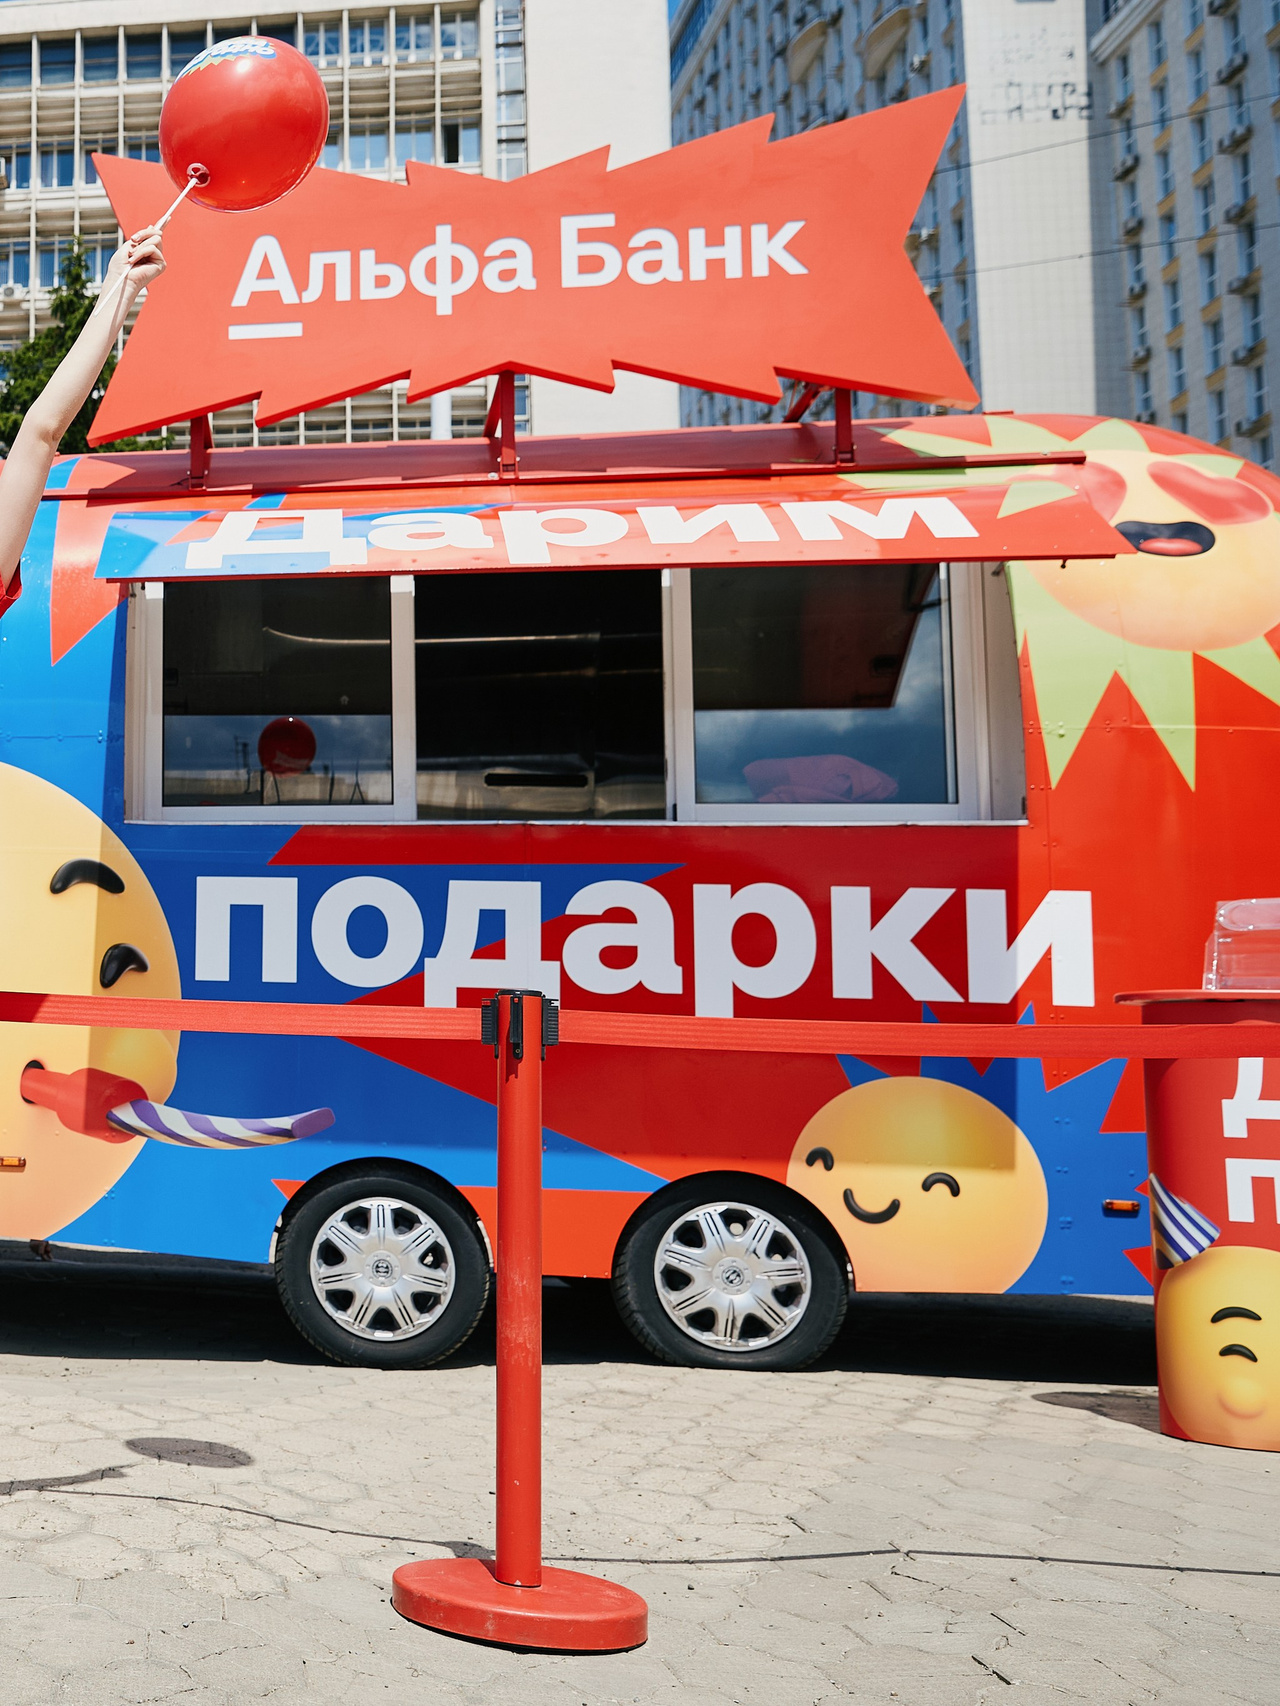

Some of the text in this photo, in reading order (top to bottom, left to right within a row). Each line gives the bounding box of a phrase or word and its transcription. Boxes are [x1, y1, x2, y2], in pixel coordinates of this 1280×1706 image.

[228, 212, 809, 341] Альфа Банк
[194, 875, 1096, 1018] подарки
